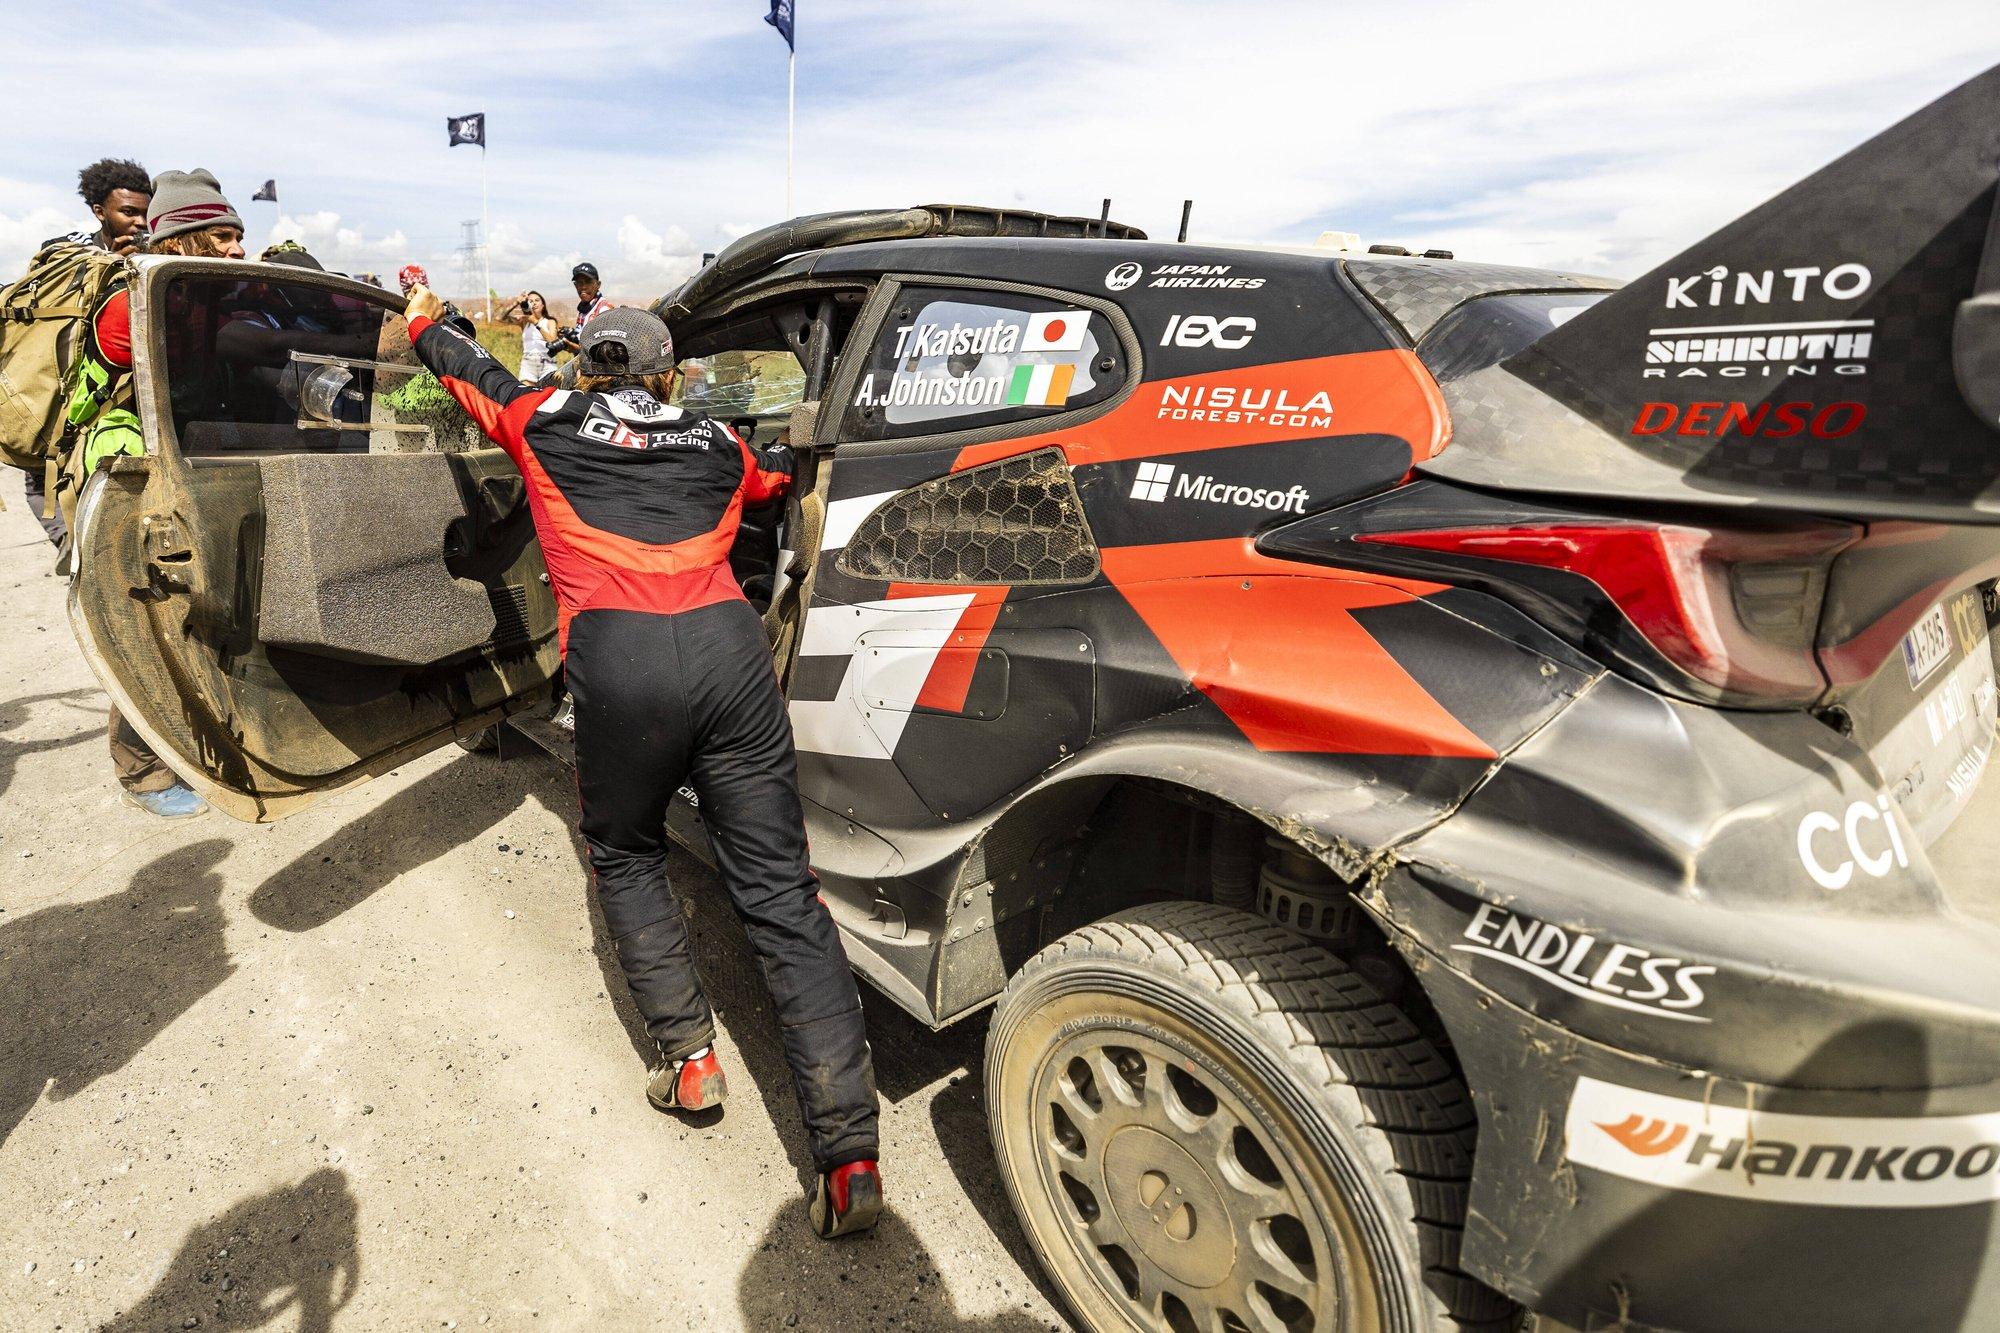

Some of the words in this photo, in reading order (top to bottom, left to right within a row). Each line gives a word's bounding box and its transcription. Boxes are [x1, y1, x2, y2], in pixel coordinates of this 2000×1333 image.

[1147, 278, 1267, 289] AIRLINES
[1150, 265, 1232, 275] JAPAN
[893, 319, 1020, 359] T.Katsuta
[1645, 333, 1872, 364] SCHROTH
[855, 371, 1006, 407] A.Johnston
[1643, 364, 1867, 379] RACING
[1161, 385, 1334, 413] NISULA
[1631, 401, 1867, 439] DENSO
[1174, 473, 1310, 514] Microsoft
[1463, 902, 1717, 1009] ENDLESS
[1686, 1133, 2000, 1182] Hankoo
